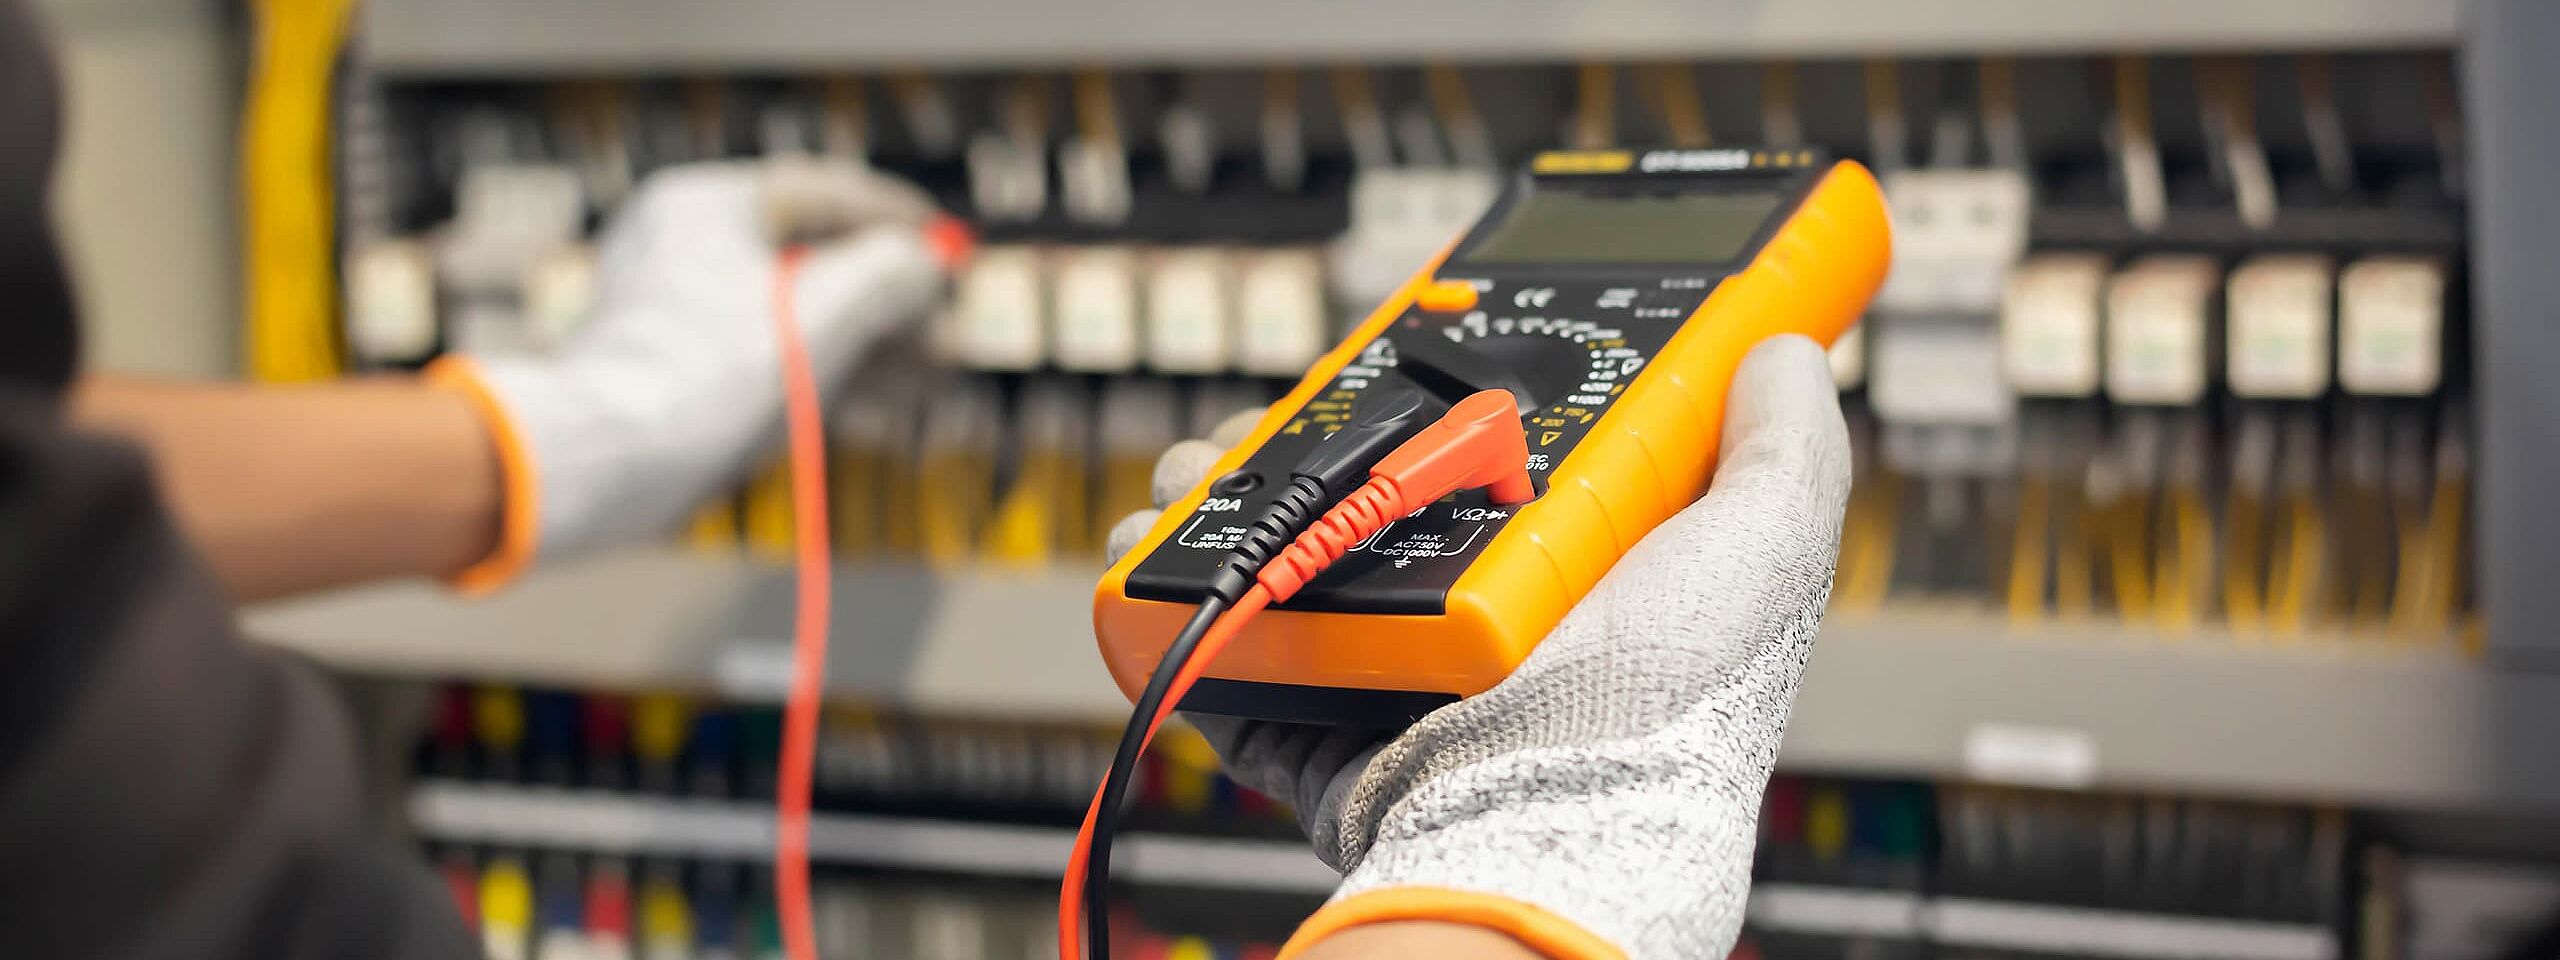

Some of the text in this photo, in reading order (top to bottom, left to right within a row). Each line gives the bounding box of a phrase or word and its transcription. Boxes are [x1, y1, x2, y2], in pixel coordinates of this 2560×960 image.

[1199, 498, 1242, 512] 20A
[1192, 541, 1237, 549] UNFUS
[1393, 541, 1445, 549] AC750V
[1383, 548, 1441, 557] DC1000V
